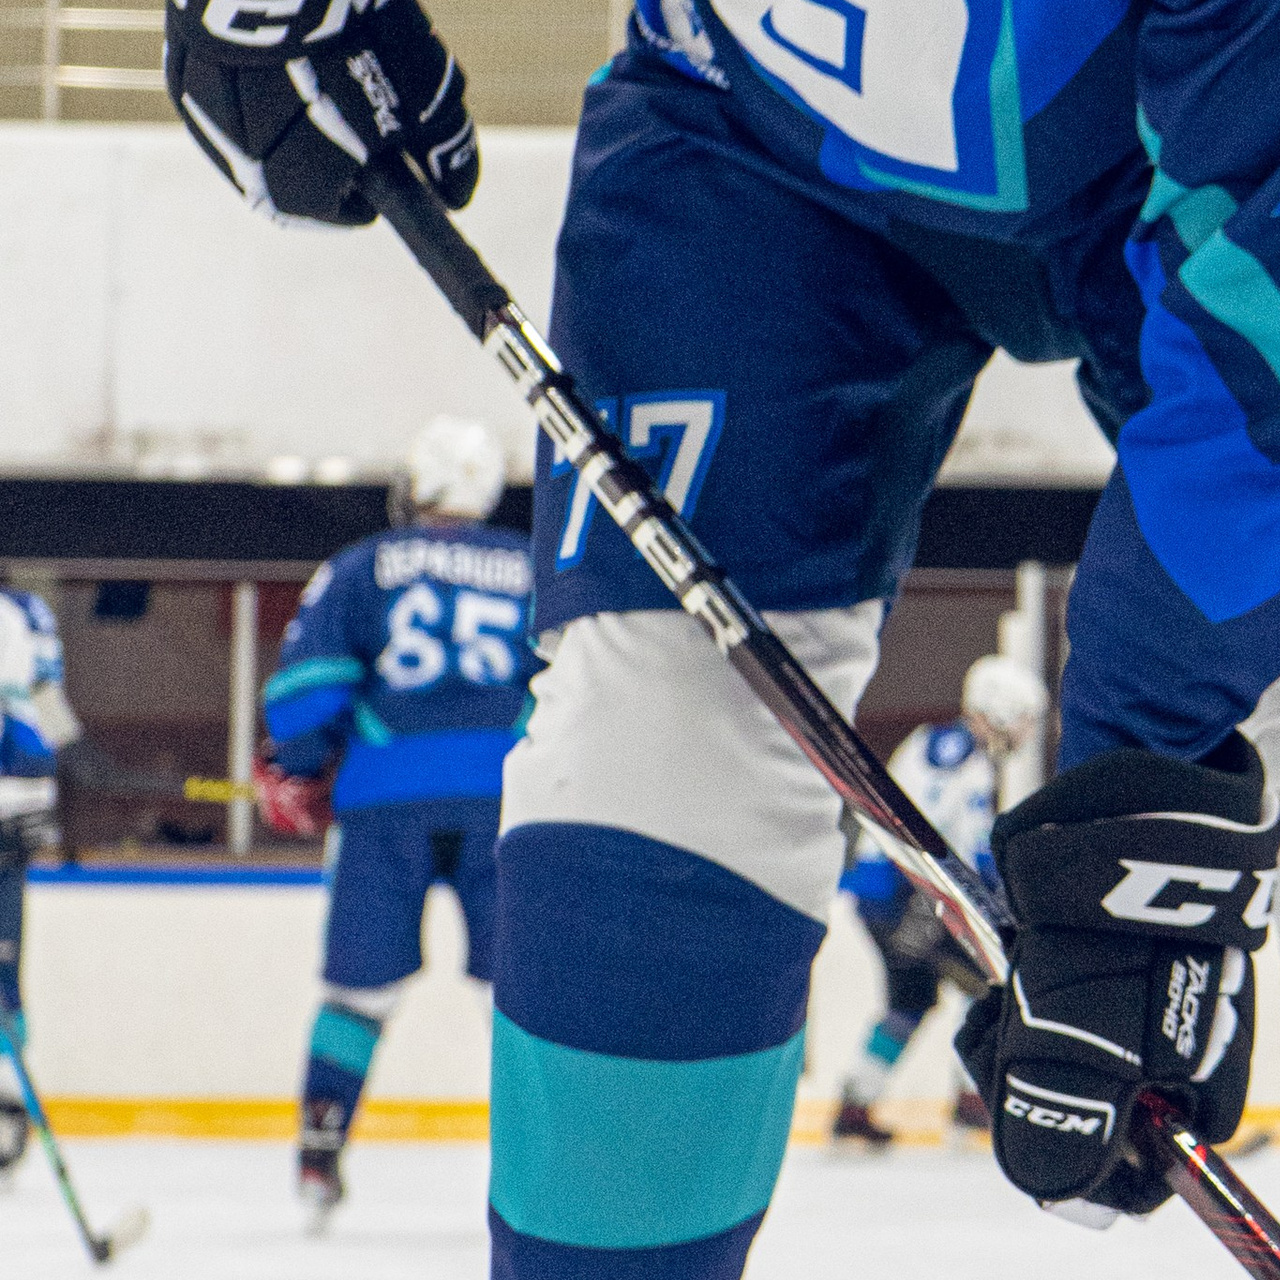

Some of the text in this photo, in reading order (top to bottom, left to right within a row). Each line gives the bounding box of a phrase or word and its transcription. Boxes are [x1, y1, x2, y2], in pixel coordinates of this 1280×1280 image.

[376, 582, 522, 691] 65
[1174, 954, 1209, 1059] TACKS
[1003, 1093, 1103, 1136] CCM
